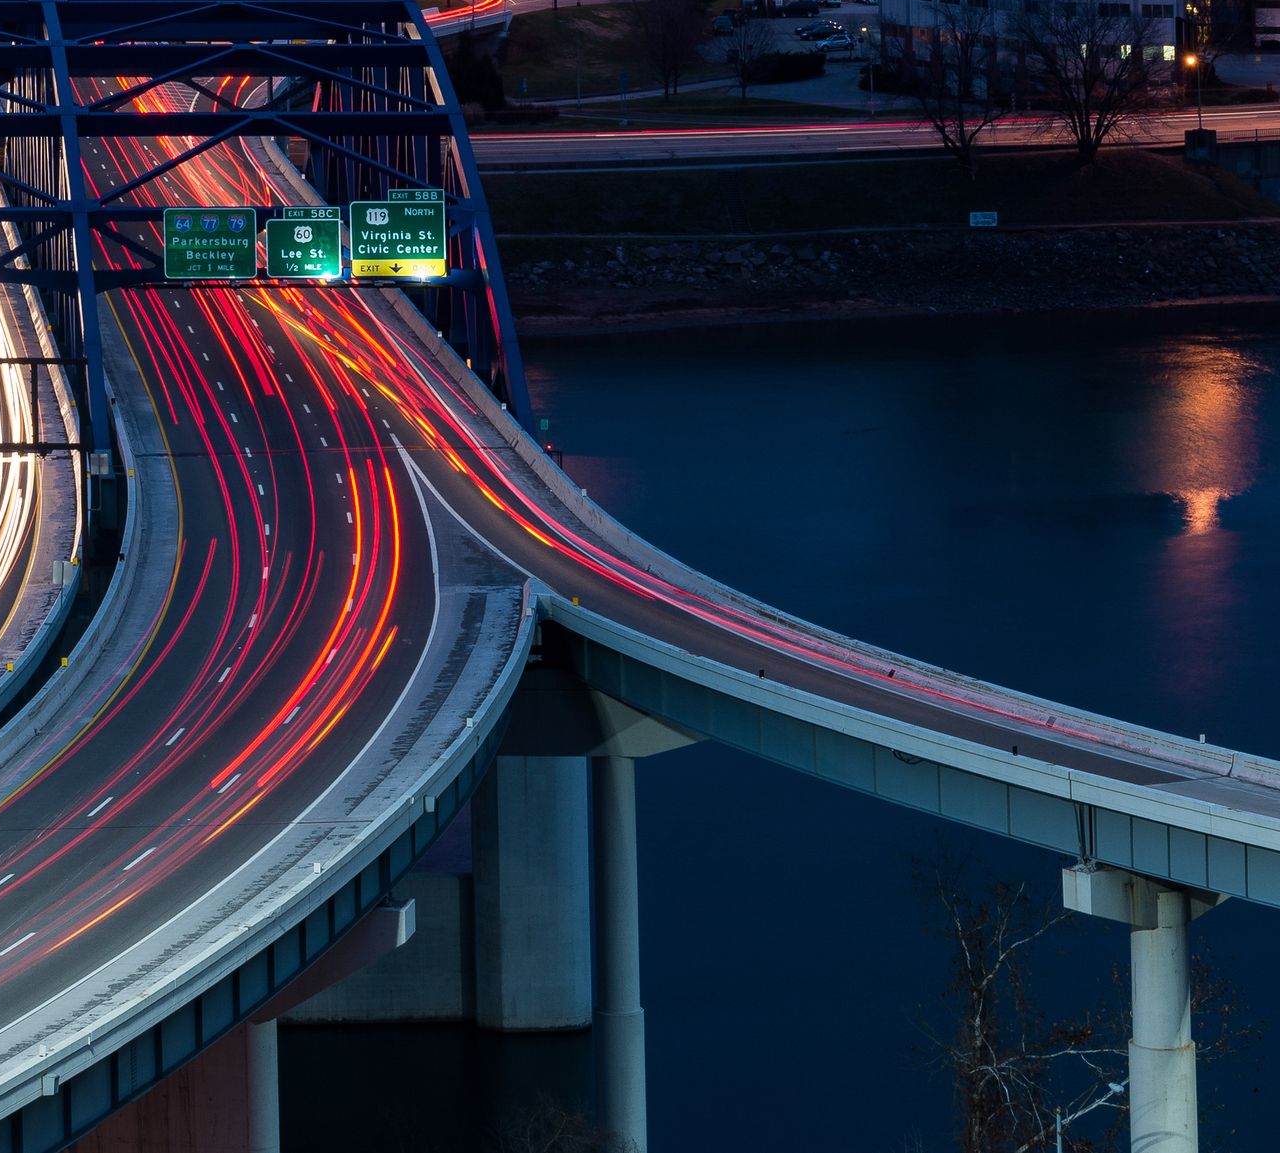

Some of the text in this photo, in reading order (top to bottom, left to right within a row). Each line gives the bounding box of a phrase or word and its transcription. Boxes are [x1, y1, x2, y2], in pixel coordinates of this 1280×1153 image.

[415, 191, 438, 200] 58B
[311, 209, 333, 218] 58C
[369, 207, 434, 222] 119 NORTH
[175, 219, 244, 229] 64 77 79
[296, 229, 311, 239] 60
[361, 230, 435, 243] Virginia St.
[172, 236, 249, 248] Parkersburg
[281, 248, 327, 259] Lee St.
[358, 244, 439, 254] Civic Center
[186, 250, 235, 261] Beckley
[208, 263, 212, 272] 1
[304, 263, 322, 271] MILE
